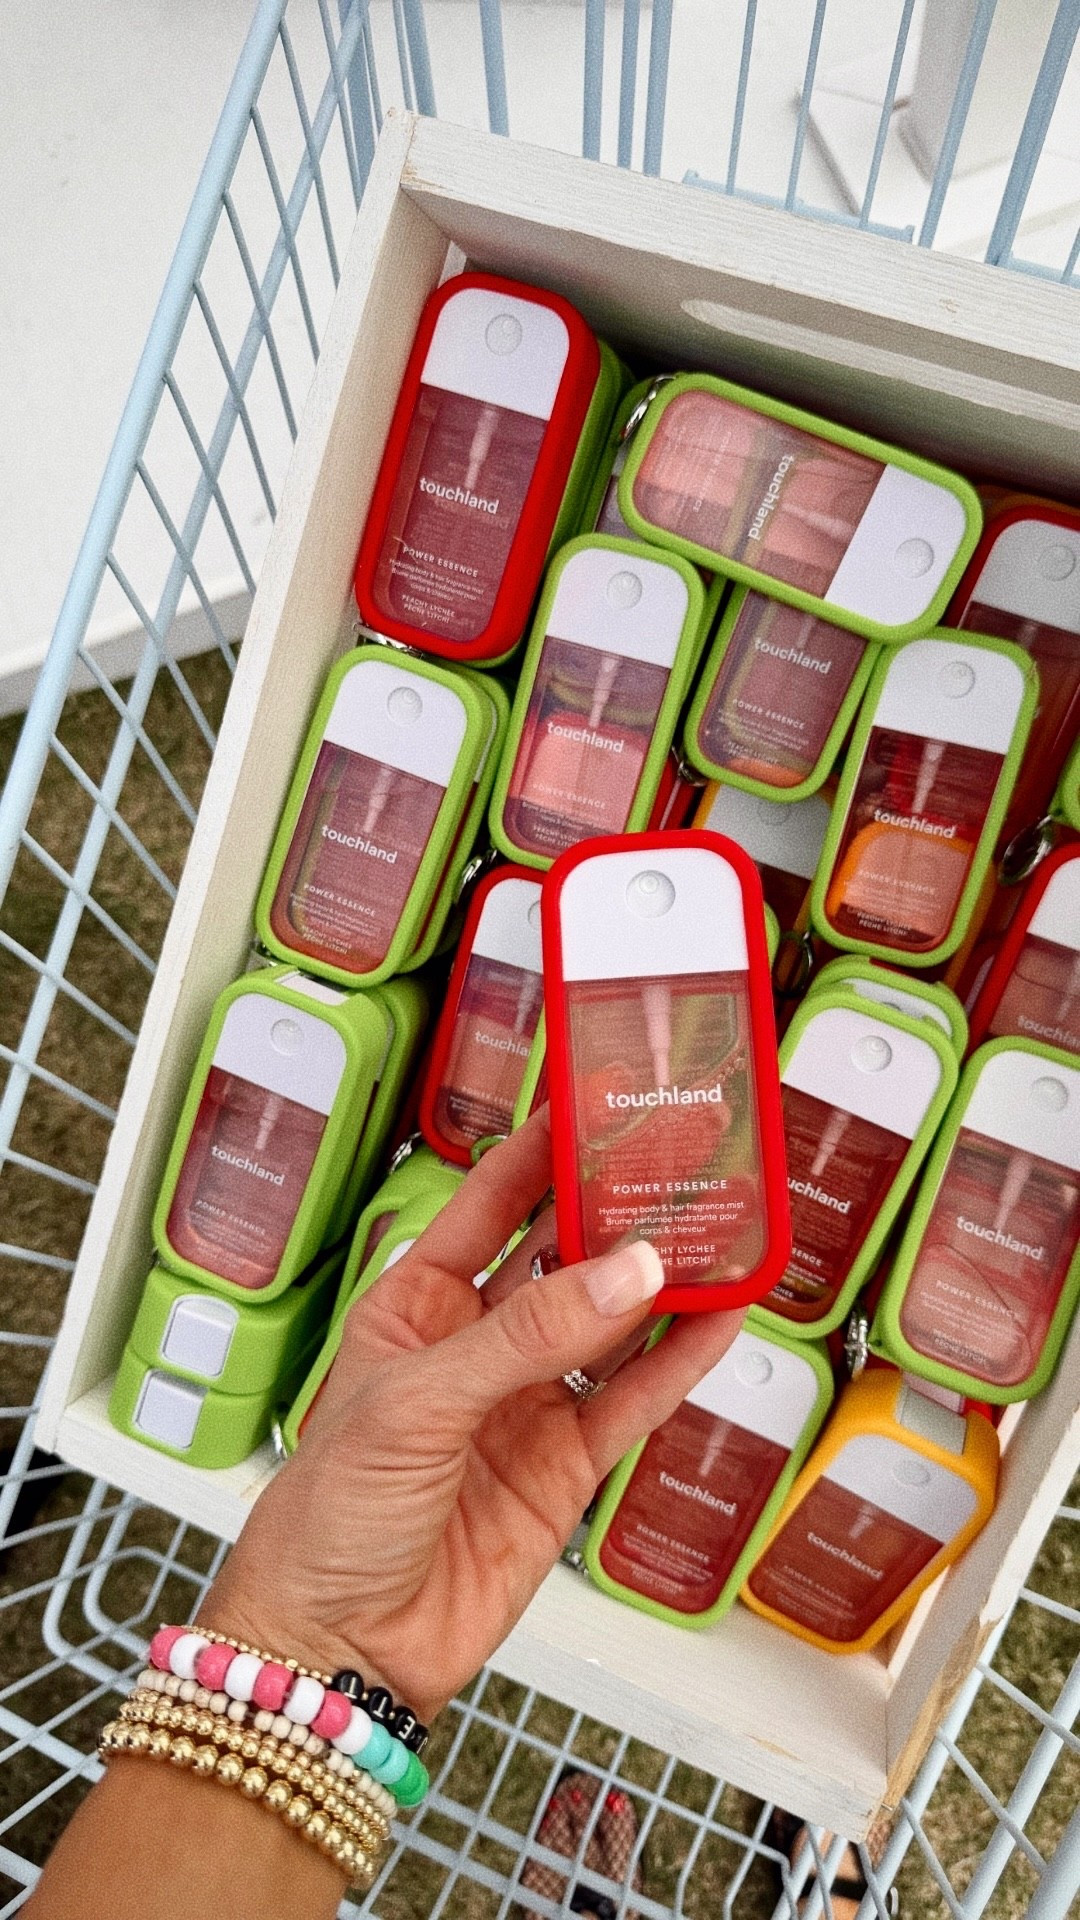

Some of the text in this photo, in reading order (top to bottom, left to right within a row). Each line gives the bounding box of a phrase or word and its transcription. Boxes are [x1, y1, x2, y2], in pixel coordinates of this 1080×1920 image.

[419, 477, 500, 515] touchland
[748, 454, 794, 541] touchland
[403, 546, 479, 578] POWER ESSENCE
[754, 637, 832, 674] touchland
[547, 722, 624, 753] touchland
[874, 808, 957, 839] touchland
[321, 825, 398, 864] touchland
[304, 883, 334, 900] POWER
[337, 896, 376, 917] ESSENCE
[475, 1031, 530, 1057] touchla
[605, 1084, 723, 1108] touchland
[211, 1145, 285, 1186] touchland
[613, 1180, 728, 1194] POWER ESSENCE
[787, 1177, 852, 1215] uchland
[598, 1207, 637, 1216] Hydrating
[640, 1205, 659, 1214] body
[686, 1202, 725, 1212] fragrance
[727, 1201, 744, 1209] mist
[606, 1213, 738, 1226] Brume parfumée hydratante pour
[640, 1225, 706, 1236] corps & cheveux
[956, 1216, 1044, 1260] touchland
[677, 1244, 716, 1253] LYCHEE
[677, 1256, 711, 1265] LITCHI
[791, 1247, 823, 1267] SENCE
[936, 1279, 971, 1300] POWER
[659, 1471, 737, 1517] touchland
[807, 1532, 884, 1581] touchland
